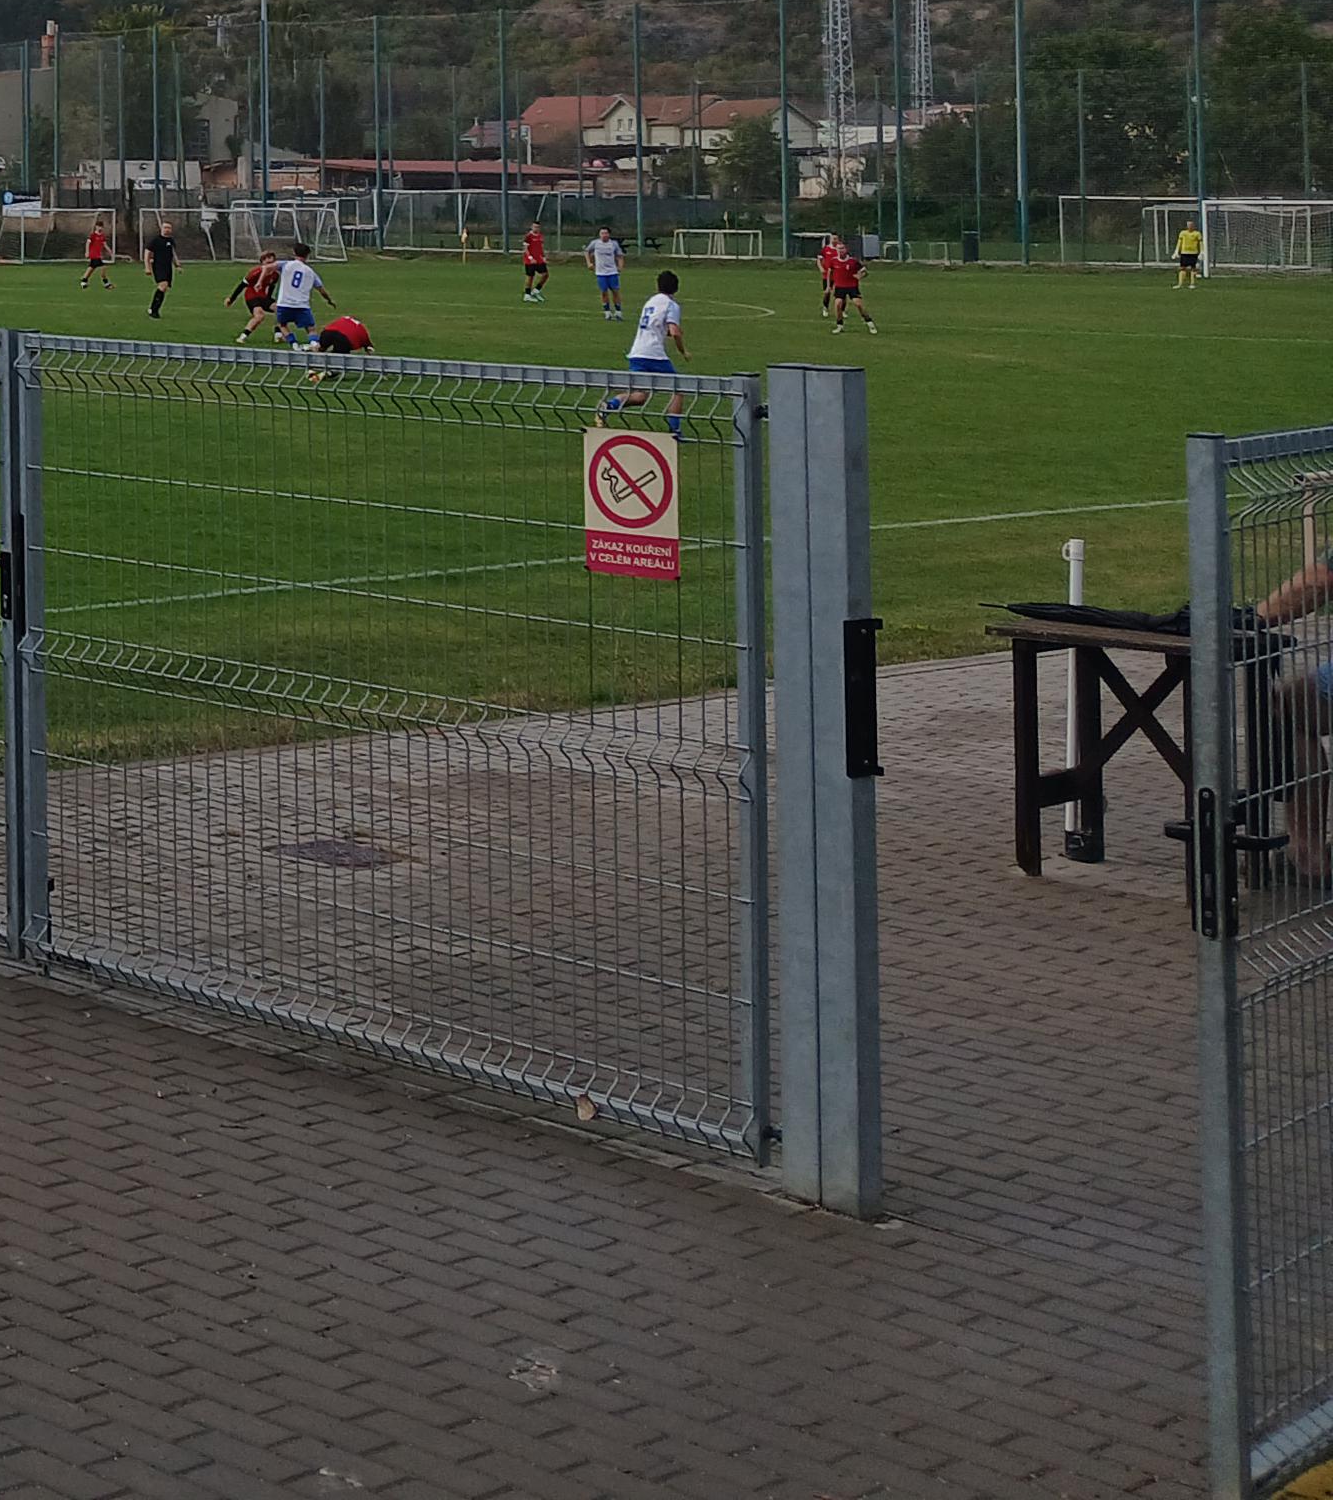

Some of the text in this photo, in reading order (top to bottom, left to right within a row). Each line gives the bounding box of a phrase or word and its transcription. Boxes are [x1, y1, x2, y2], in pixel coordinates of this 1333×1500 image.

[291, 271, 303, 288] 8
[592, 539, 672, 557] ZÁKAZ KOUŘENÍ
[589, 552, 675, 570] V CELÉM AREÁLU
